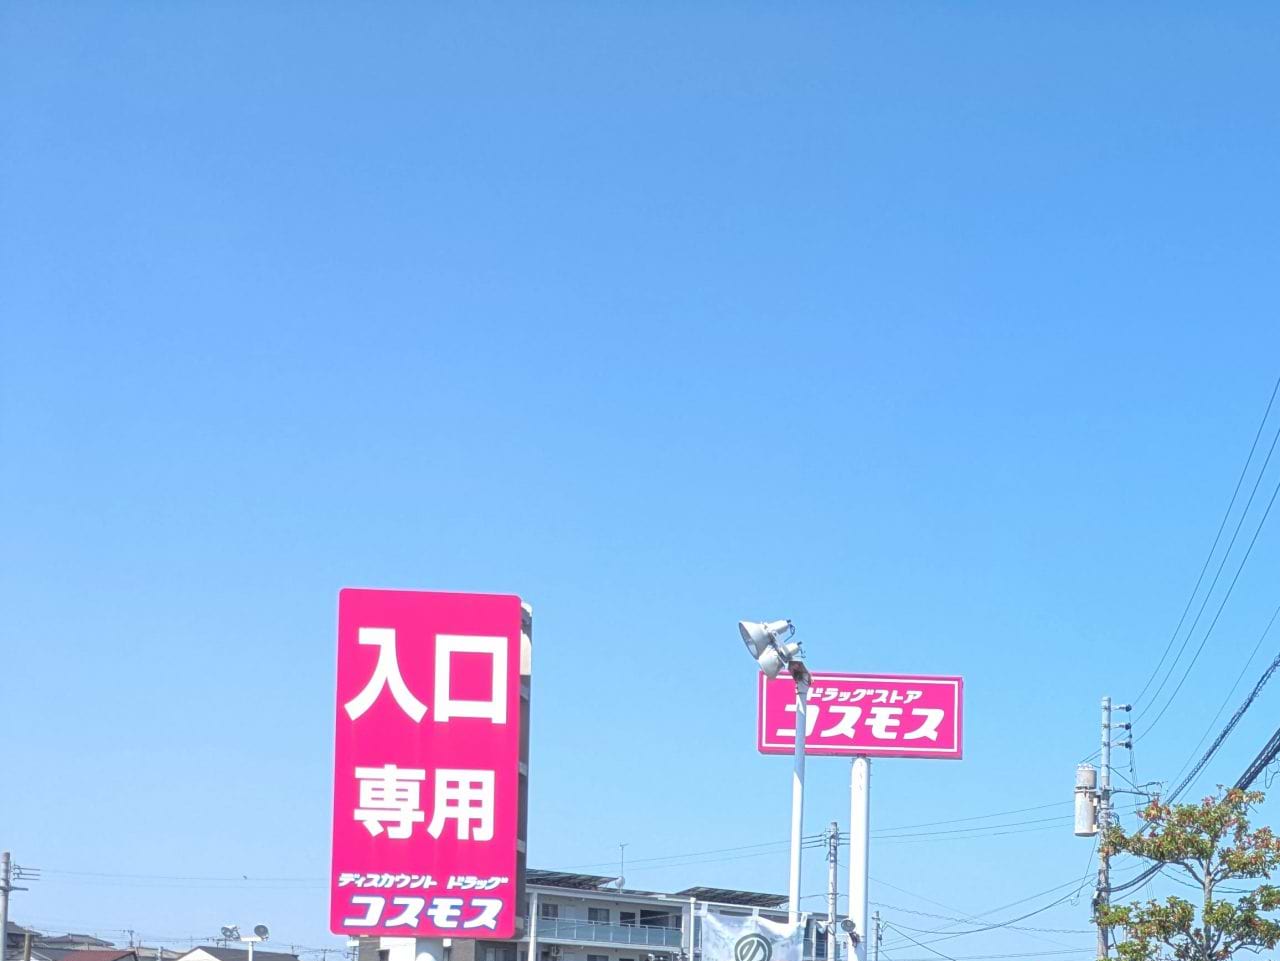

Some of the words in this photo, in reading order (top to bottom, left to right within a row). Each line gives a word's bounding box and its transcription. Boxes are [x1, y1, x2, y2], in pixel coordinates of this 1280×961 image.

[344, 627, 508, 724] 入口
[806, 687, 923, 704] ドラッグストア
[775, 702, 945, 742] コスモス
[353, 764, 496, 842] 専用
[338, 872, 438, 889] ディスカウント
[446, 875, 509, 890] ドラッグ
[343, 895, 503, 931] コスモス
